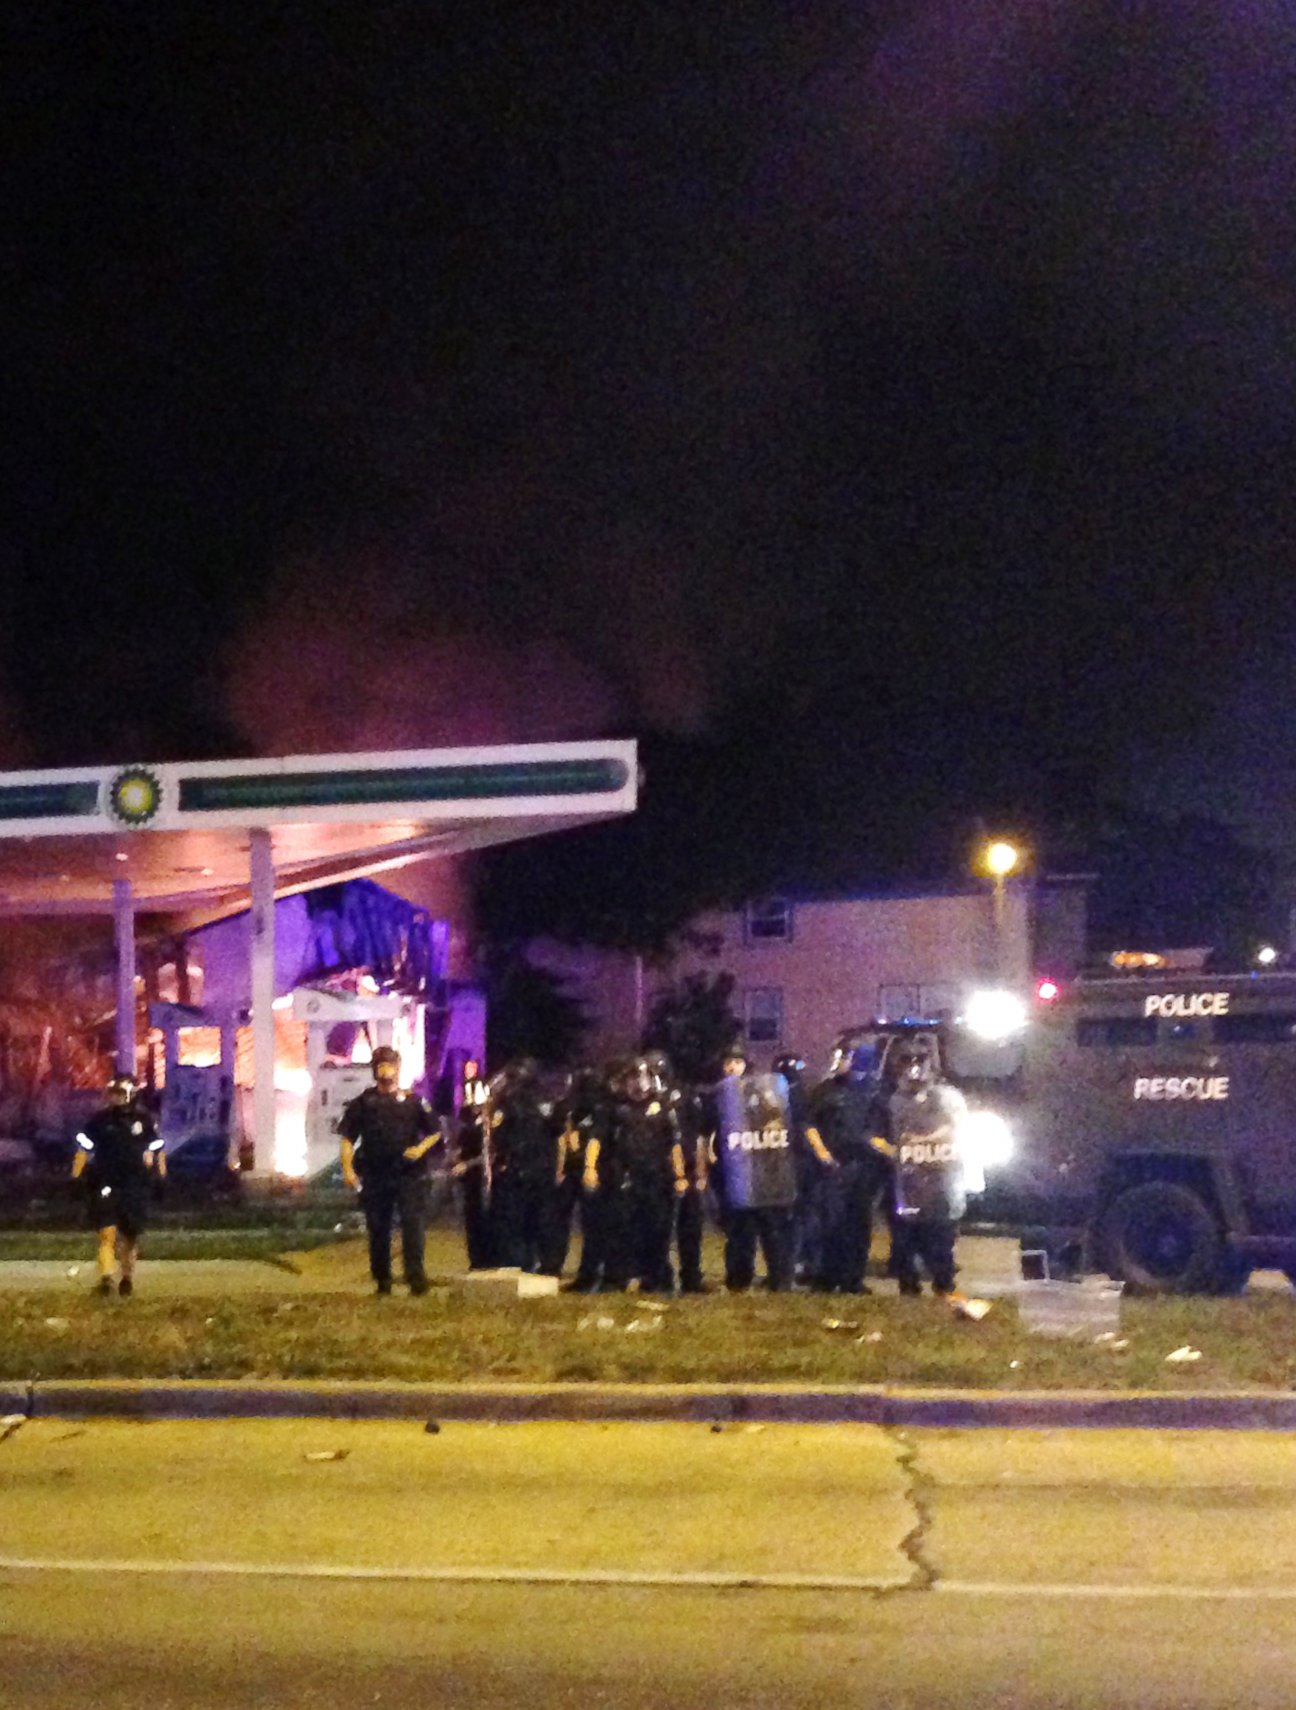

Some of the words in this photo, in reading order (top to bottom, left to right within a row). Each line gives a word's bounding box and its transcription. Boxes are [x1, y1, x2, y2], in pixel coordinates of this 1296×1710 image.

[1144, 992, 1230, 1017] POLICE
[1134, 1077, 1230, 1100] RESCUE
[727, 1129, 790, 1151] POLICE
[900, 1143, 961, 1164] POLIC
